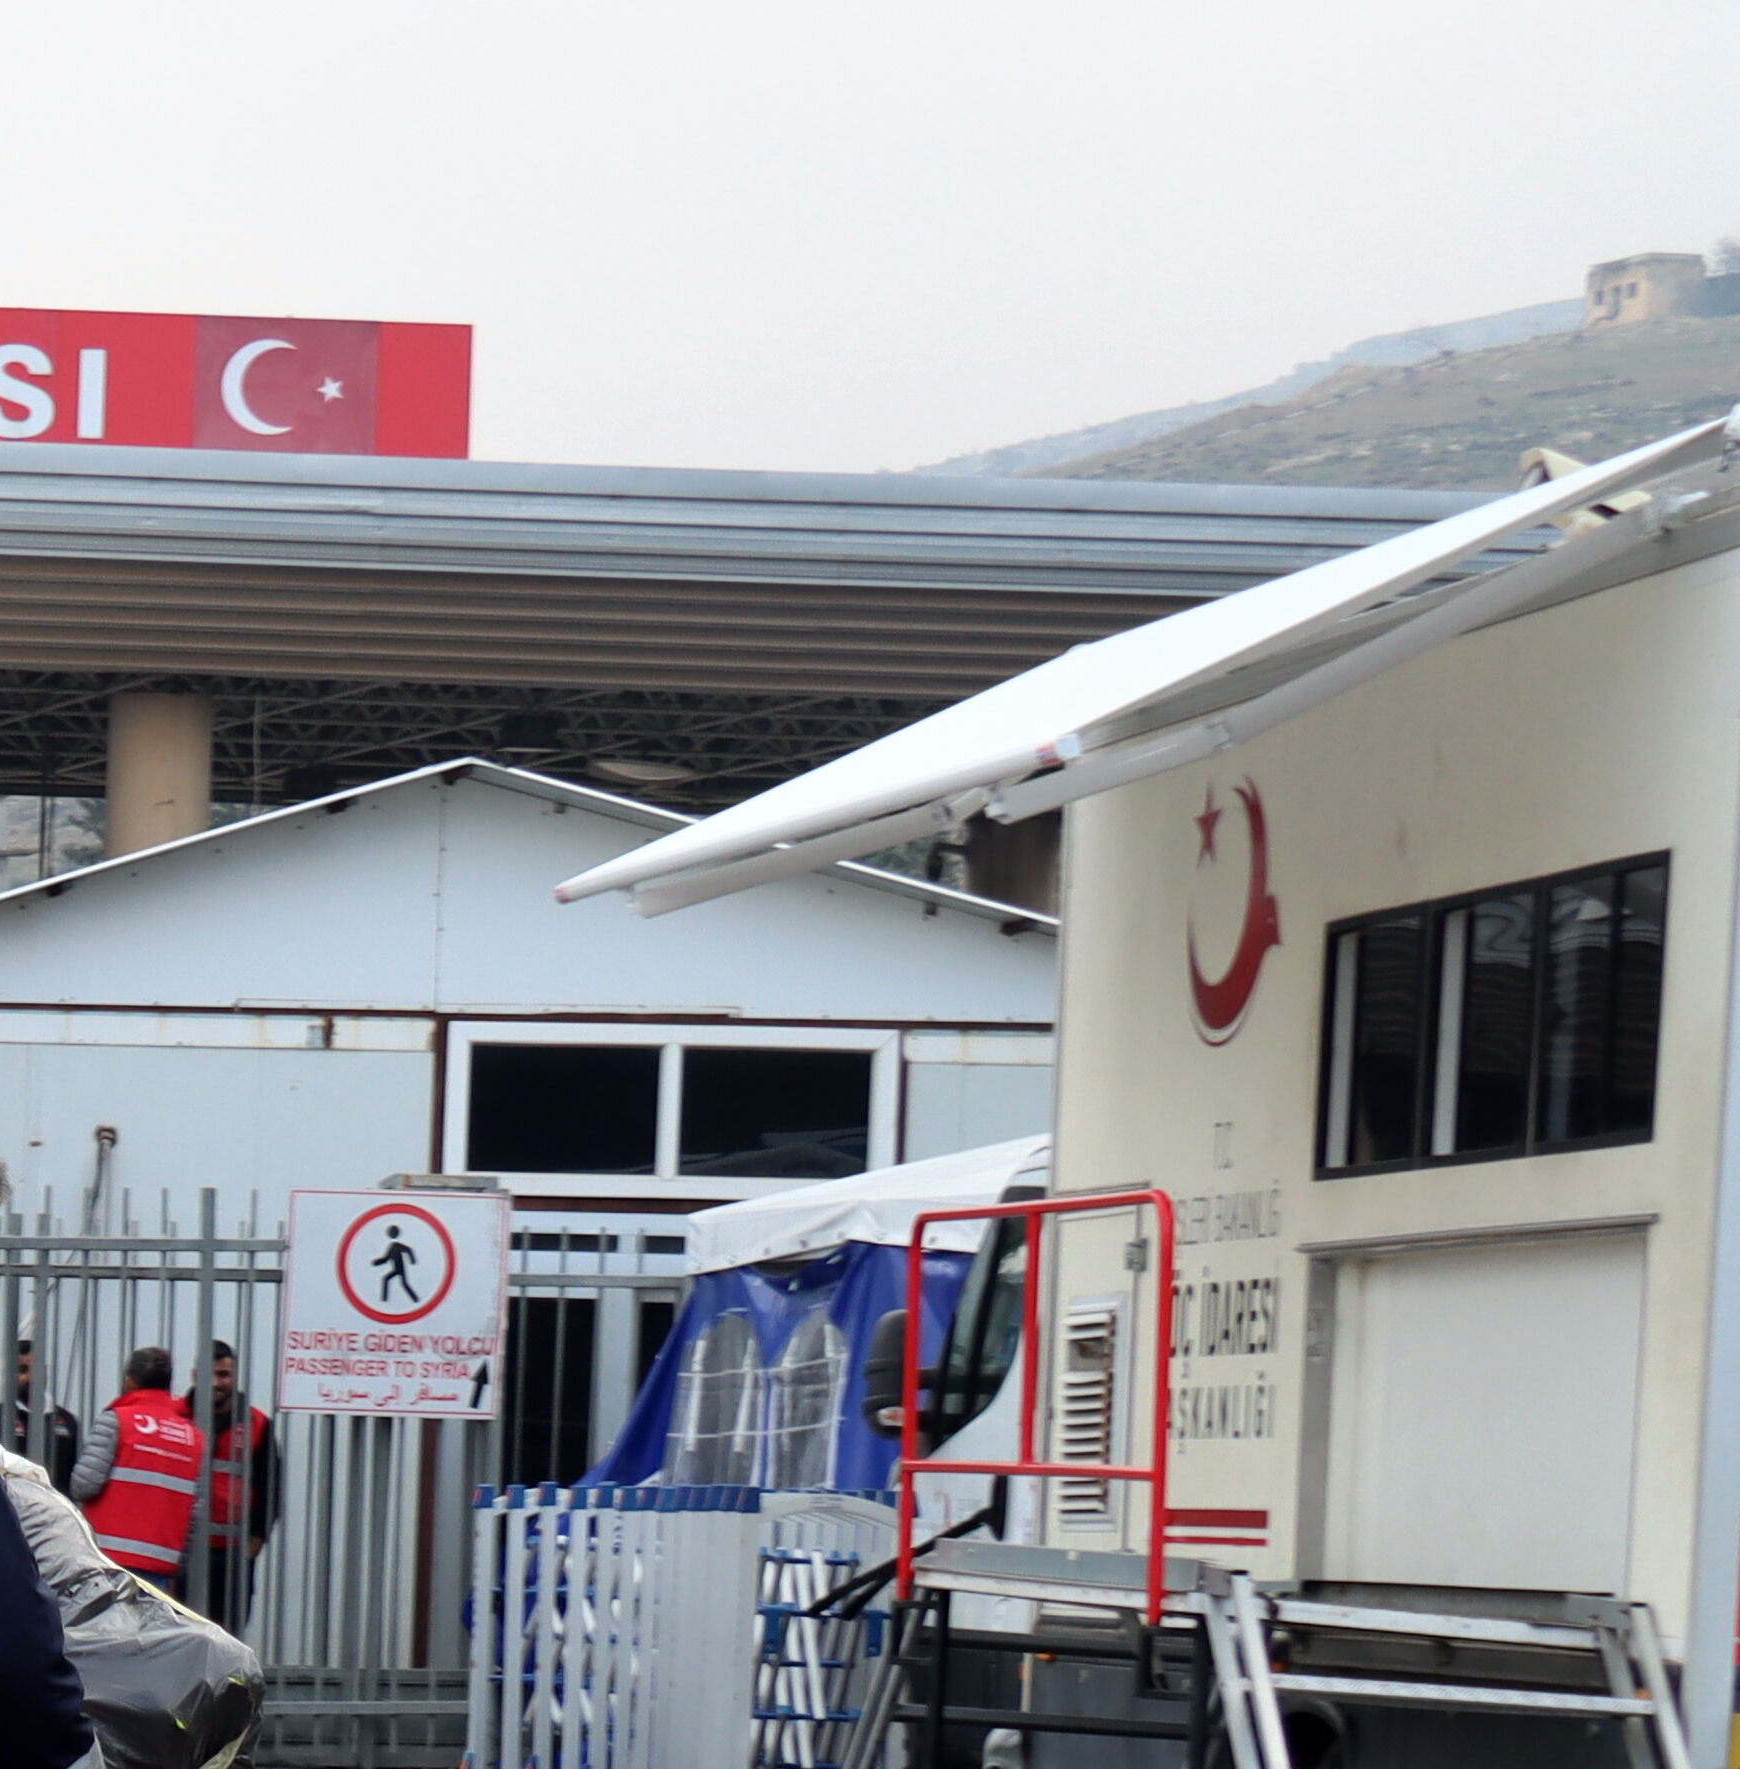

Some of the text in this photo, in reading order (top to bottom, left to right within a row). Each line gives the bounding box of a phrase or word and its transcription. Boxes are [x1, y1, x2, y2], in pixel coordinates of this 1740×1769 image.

[431, 1336, 495, 1356] YOLCU
[285, 1357, 470, 1379] PASSENGER TO SYRIA
